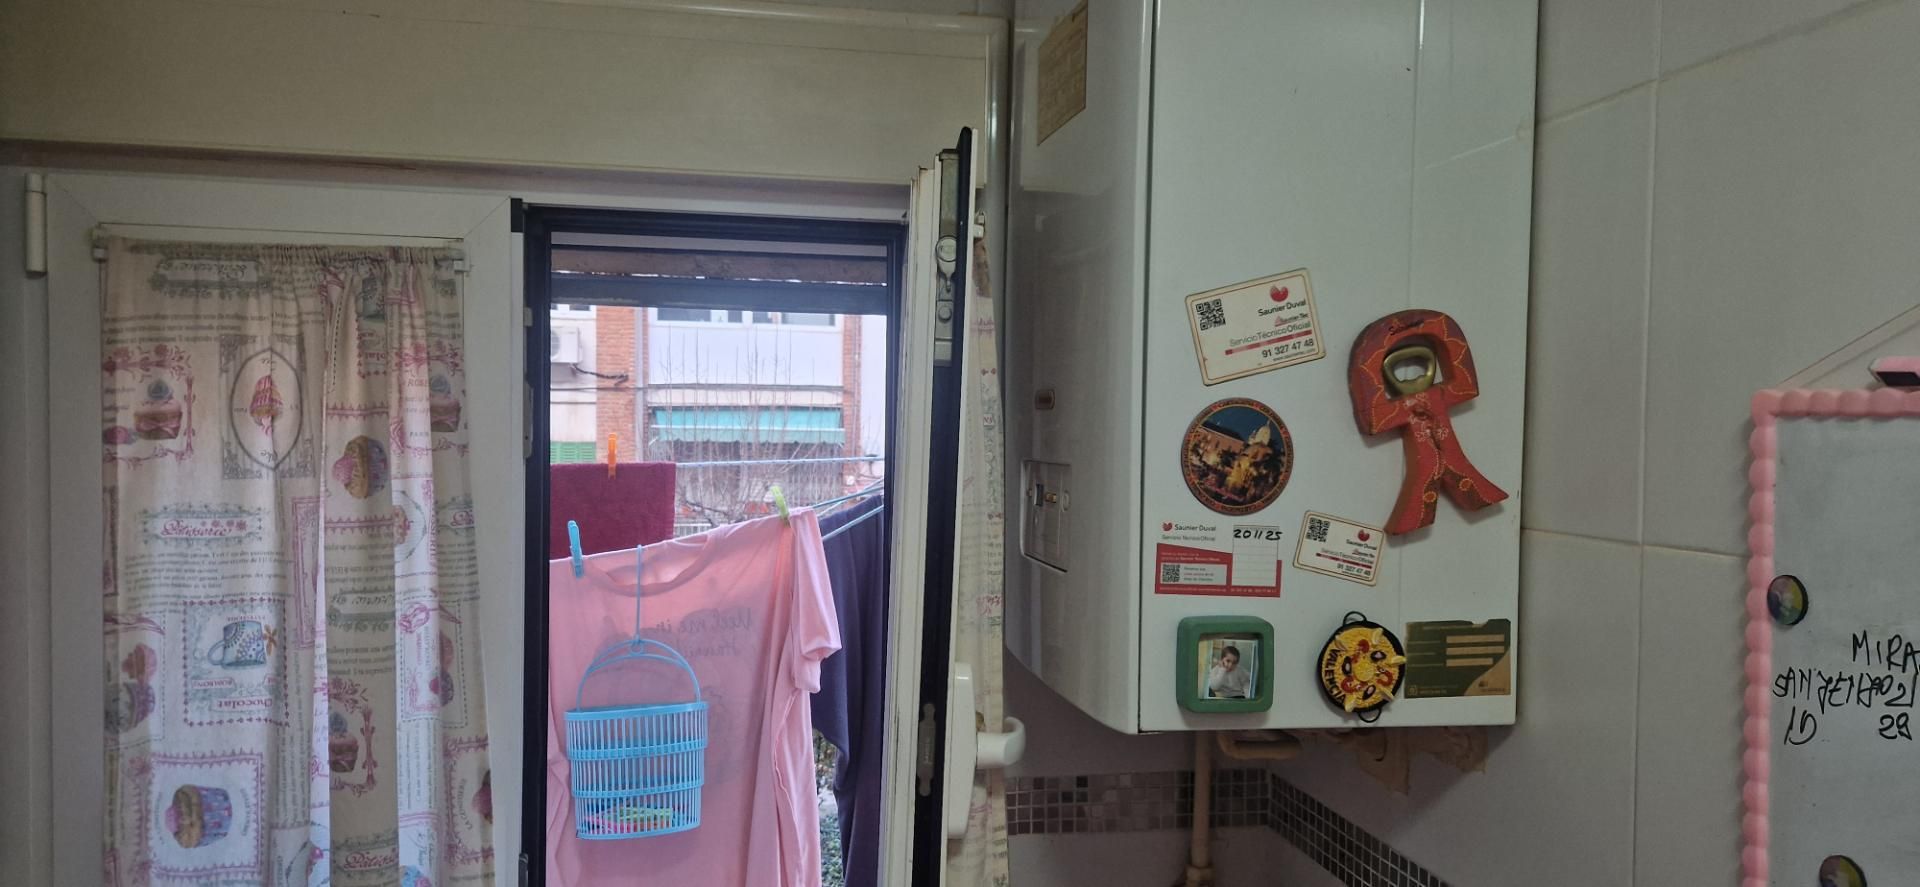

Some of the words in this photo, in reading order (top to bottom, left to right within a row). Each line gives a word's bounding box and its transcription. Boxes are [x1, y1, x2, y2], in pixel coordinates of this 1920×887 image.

[1258, 305, 1285, 317] Saunier
[1286, 299, 1306, 310] Duval
[1287, 320, 1311, 333] Oficial
[1262, 349, 1272, 358] 91
[1274, 345, 1289, 355] 327
[1292, 341, 1301, 350] 47
[1304, 338, 1314, 347] 48
[1175, 523, 1198, 531] Saunier
[1233, 529, 1251, 539] 20
[1254, 530, 1262, 540] 11
[1265, 530, 1283, 541] 25
[1324, 649, 1346, 703] VALENCIA
[1772, 667, 1812, 701] SAN
